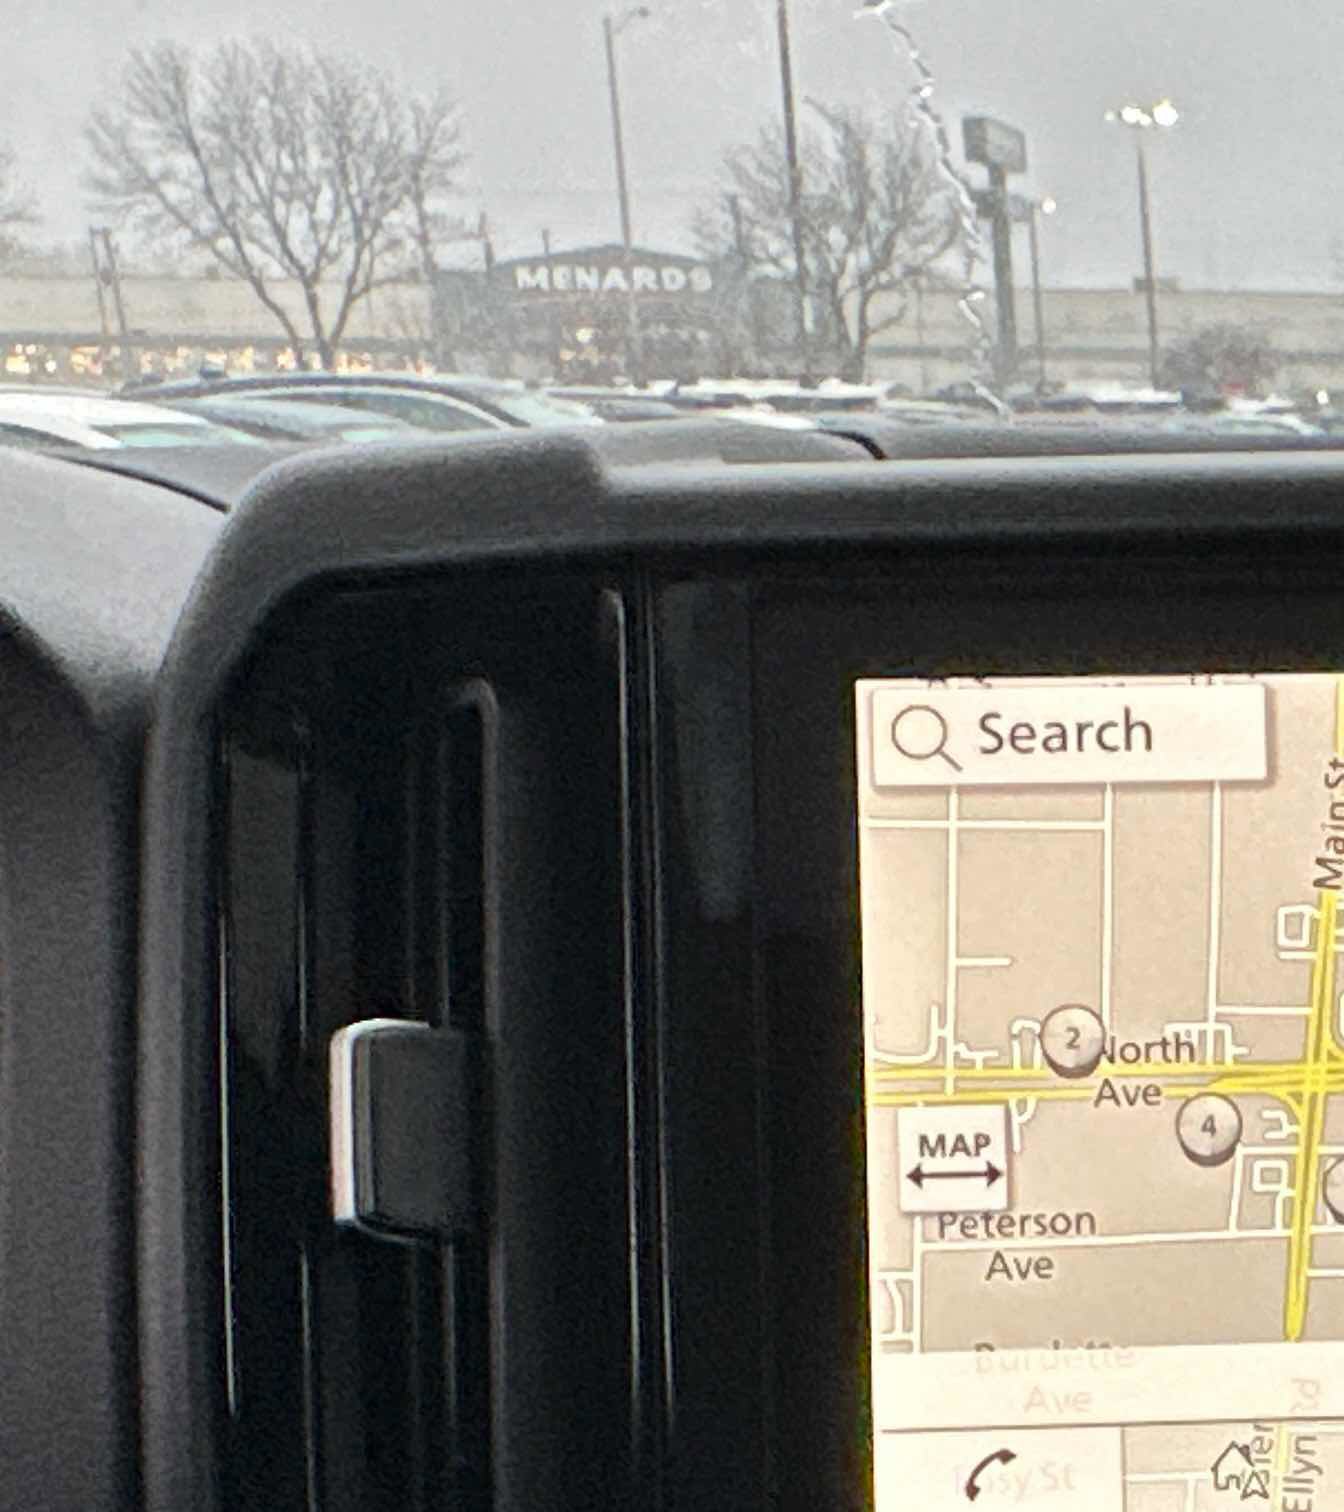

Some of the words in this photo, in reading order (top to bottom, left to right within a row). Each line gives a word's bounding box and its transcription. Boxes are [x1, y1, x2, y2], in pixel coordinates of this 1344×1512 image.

[515, 265, 713, 291] MENARDS
[979, 706, 1152, 754] Search
[1065, 1026, 1081, 1049] 2
[1094, 1077, 1162, 1108] Ave
[1200, 1114, 1217, 1137] 4
[918, 1131, 991, 1160] MAP
[937, 1207, 1096, 1241] Peterson
[985, 1252, 1055, 1282] Ave
[1023, 1386, 1094, 1414] Ave
